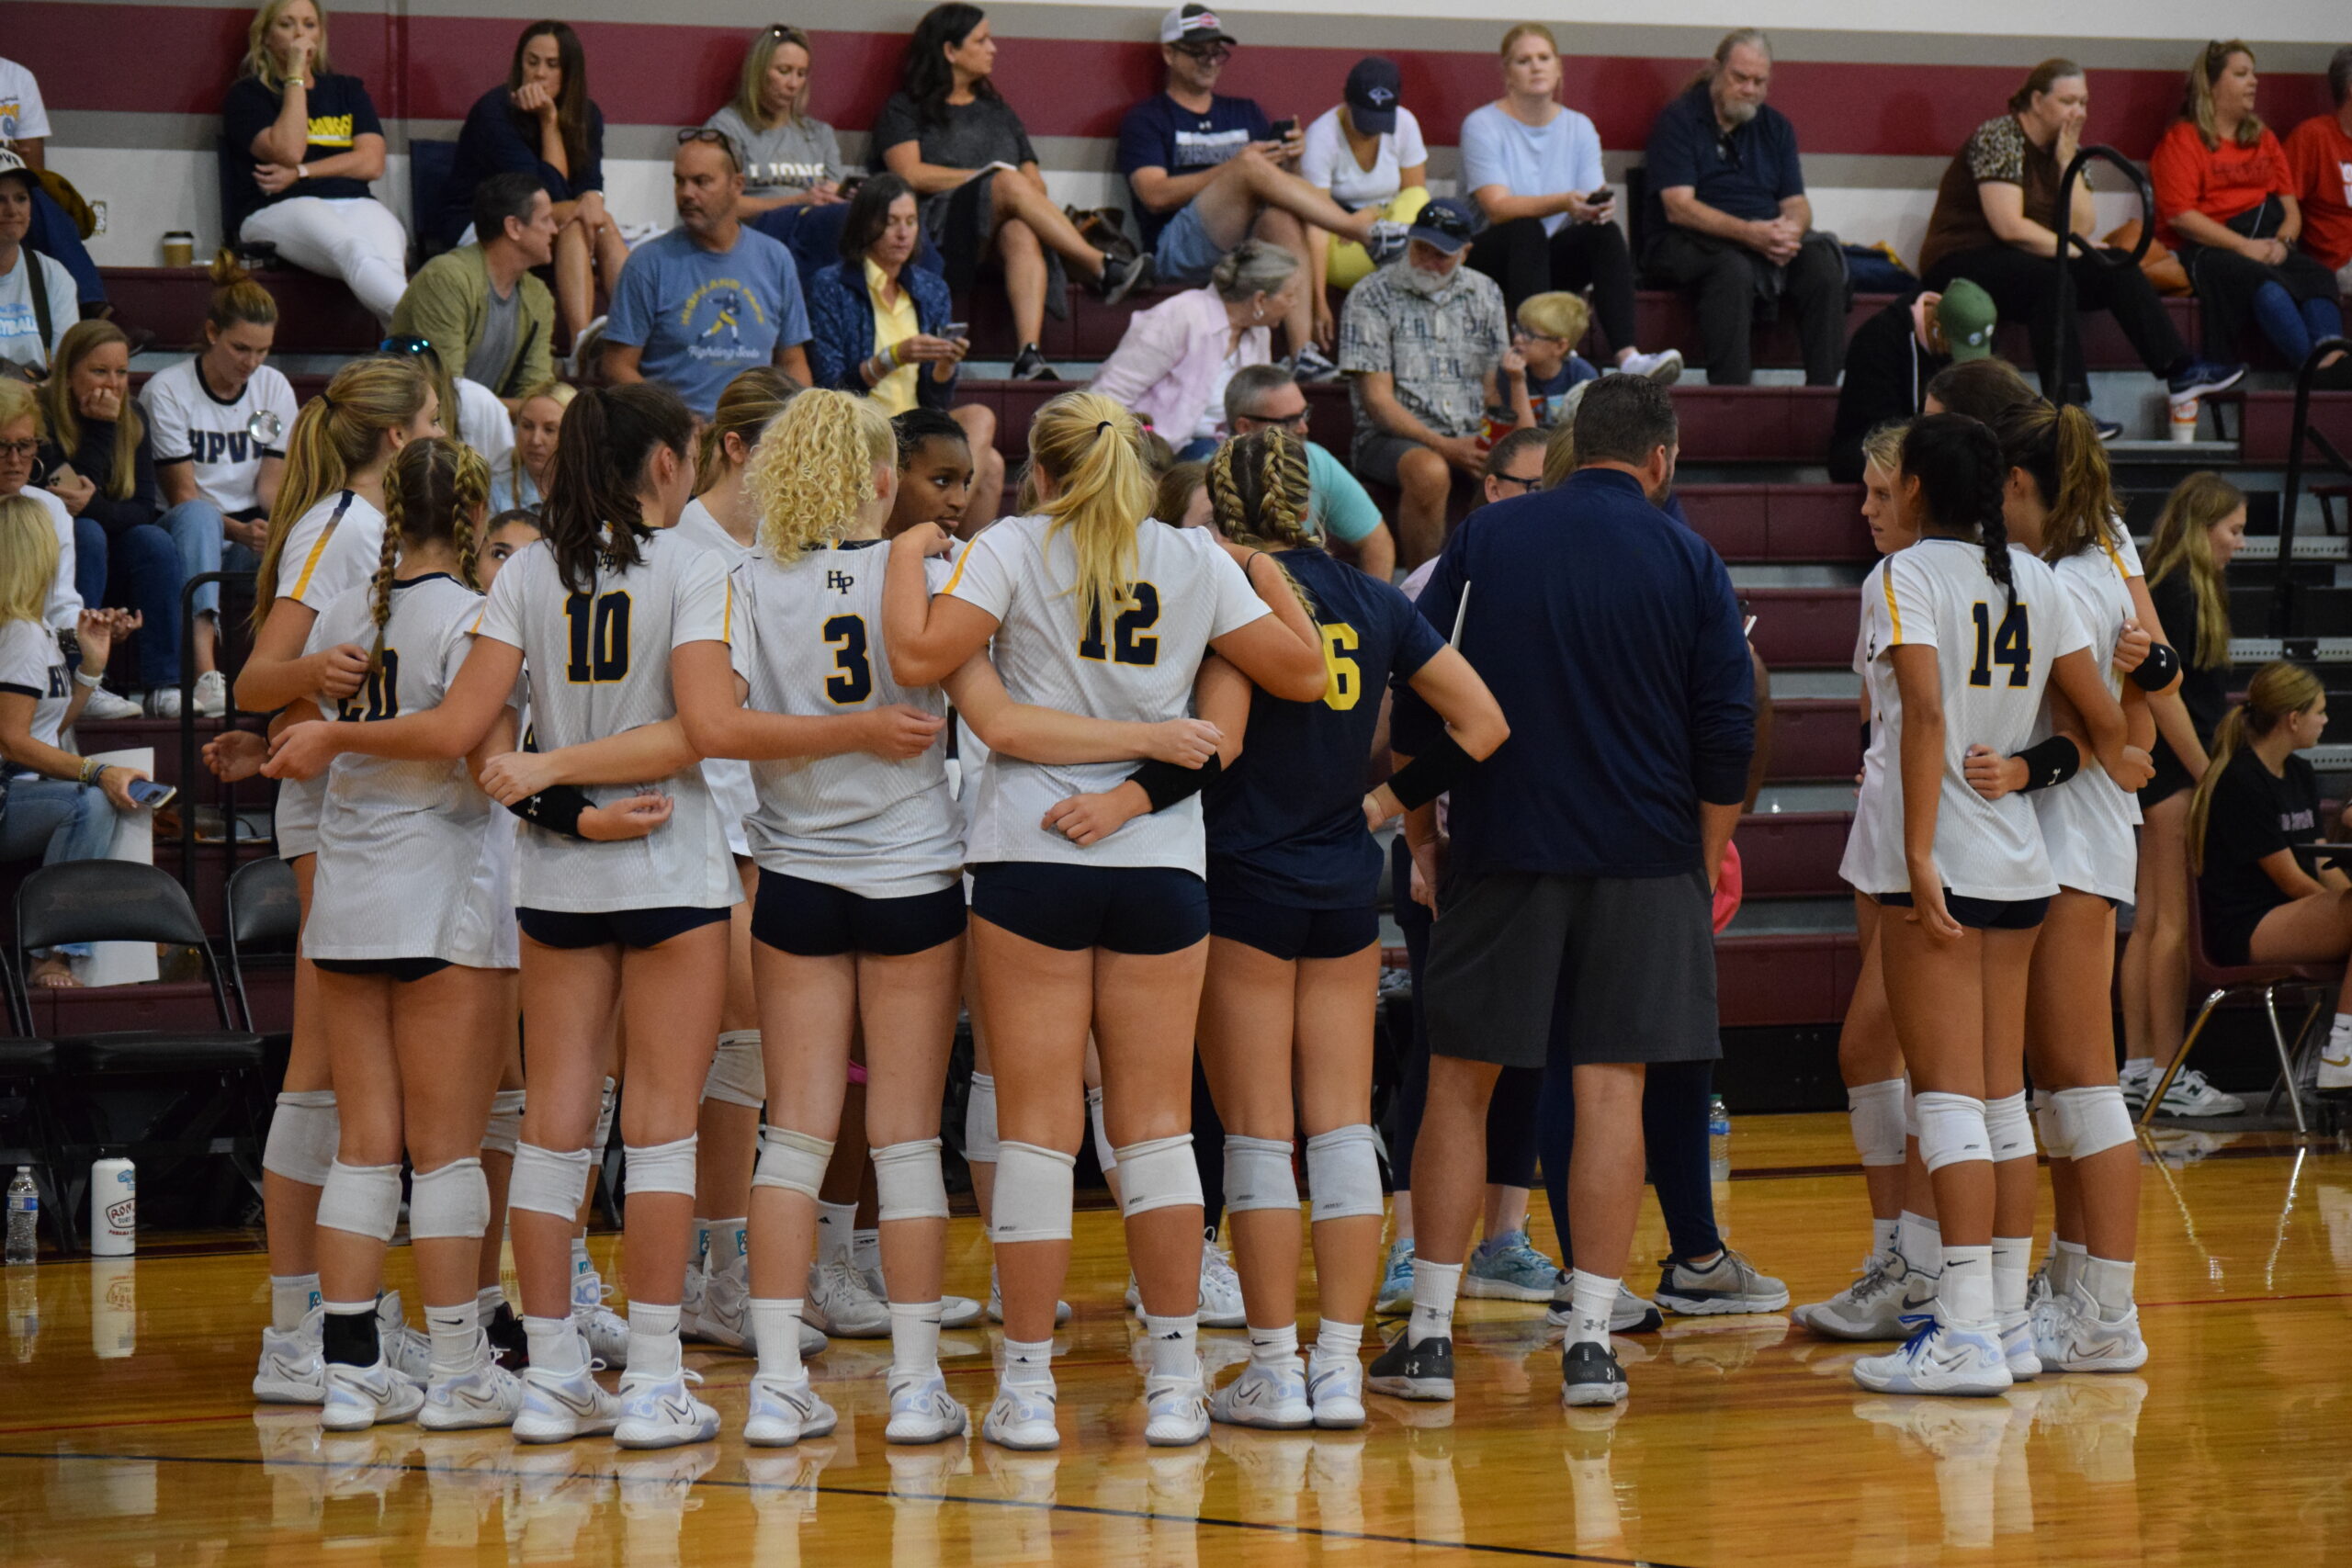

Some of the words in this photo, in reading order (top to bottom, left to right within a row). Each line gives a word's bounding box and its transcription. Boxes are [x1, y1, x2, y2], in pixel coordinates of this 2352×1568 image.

[828, 570, 854, 595] HP
[1077, 581, 1162, 668] 12
[562, 588, 633, 684] 10
[821, 612, 873, 706] 3
[1321, 622, 1361, 711] 6
[1969, 600, 2031, 690] 14
